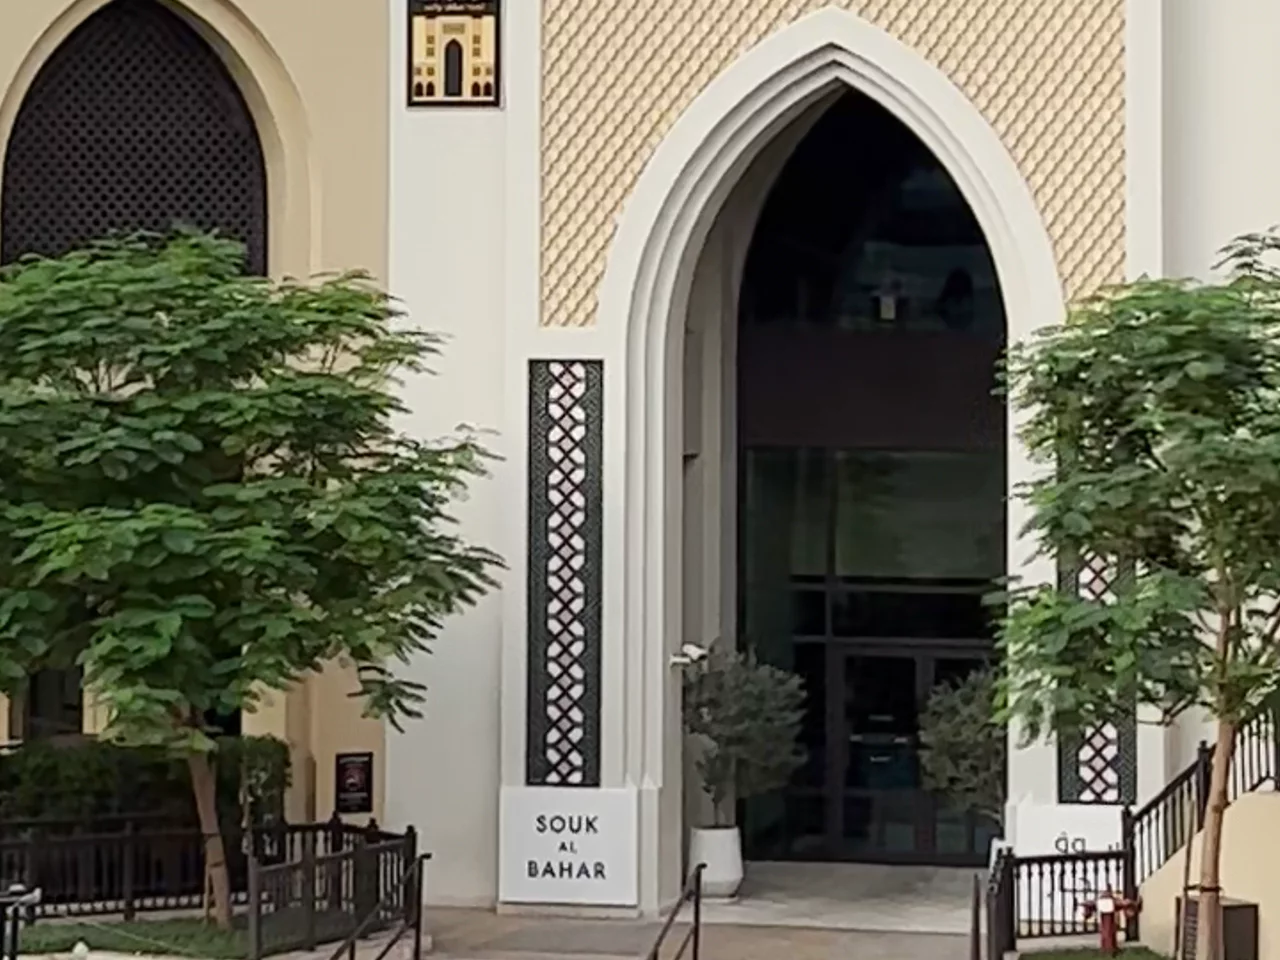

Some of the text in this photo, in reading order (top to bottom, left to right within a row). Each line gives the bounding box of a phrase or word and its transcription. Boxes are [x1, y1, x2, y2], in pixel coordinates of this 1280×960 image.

[536, 814, 599, 834] SOUK
[558, 840, 578, 855] AL
[527, 860, 606, 880] BAHAR
